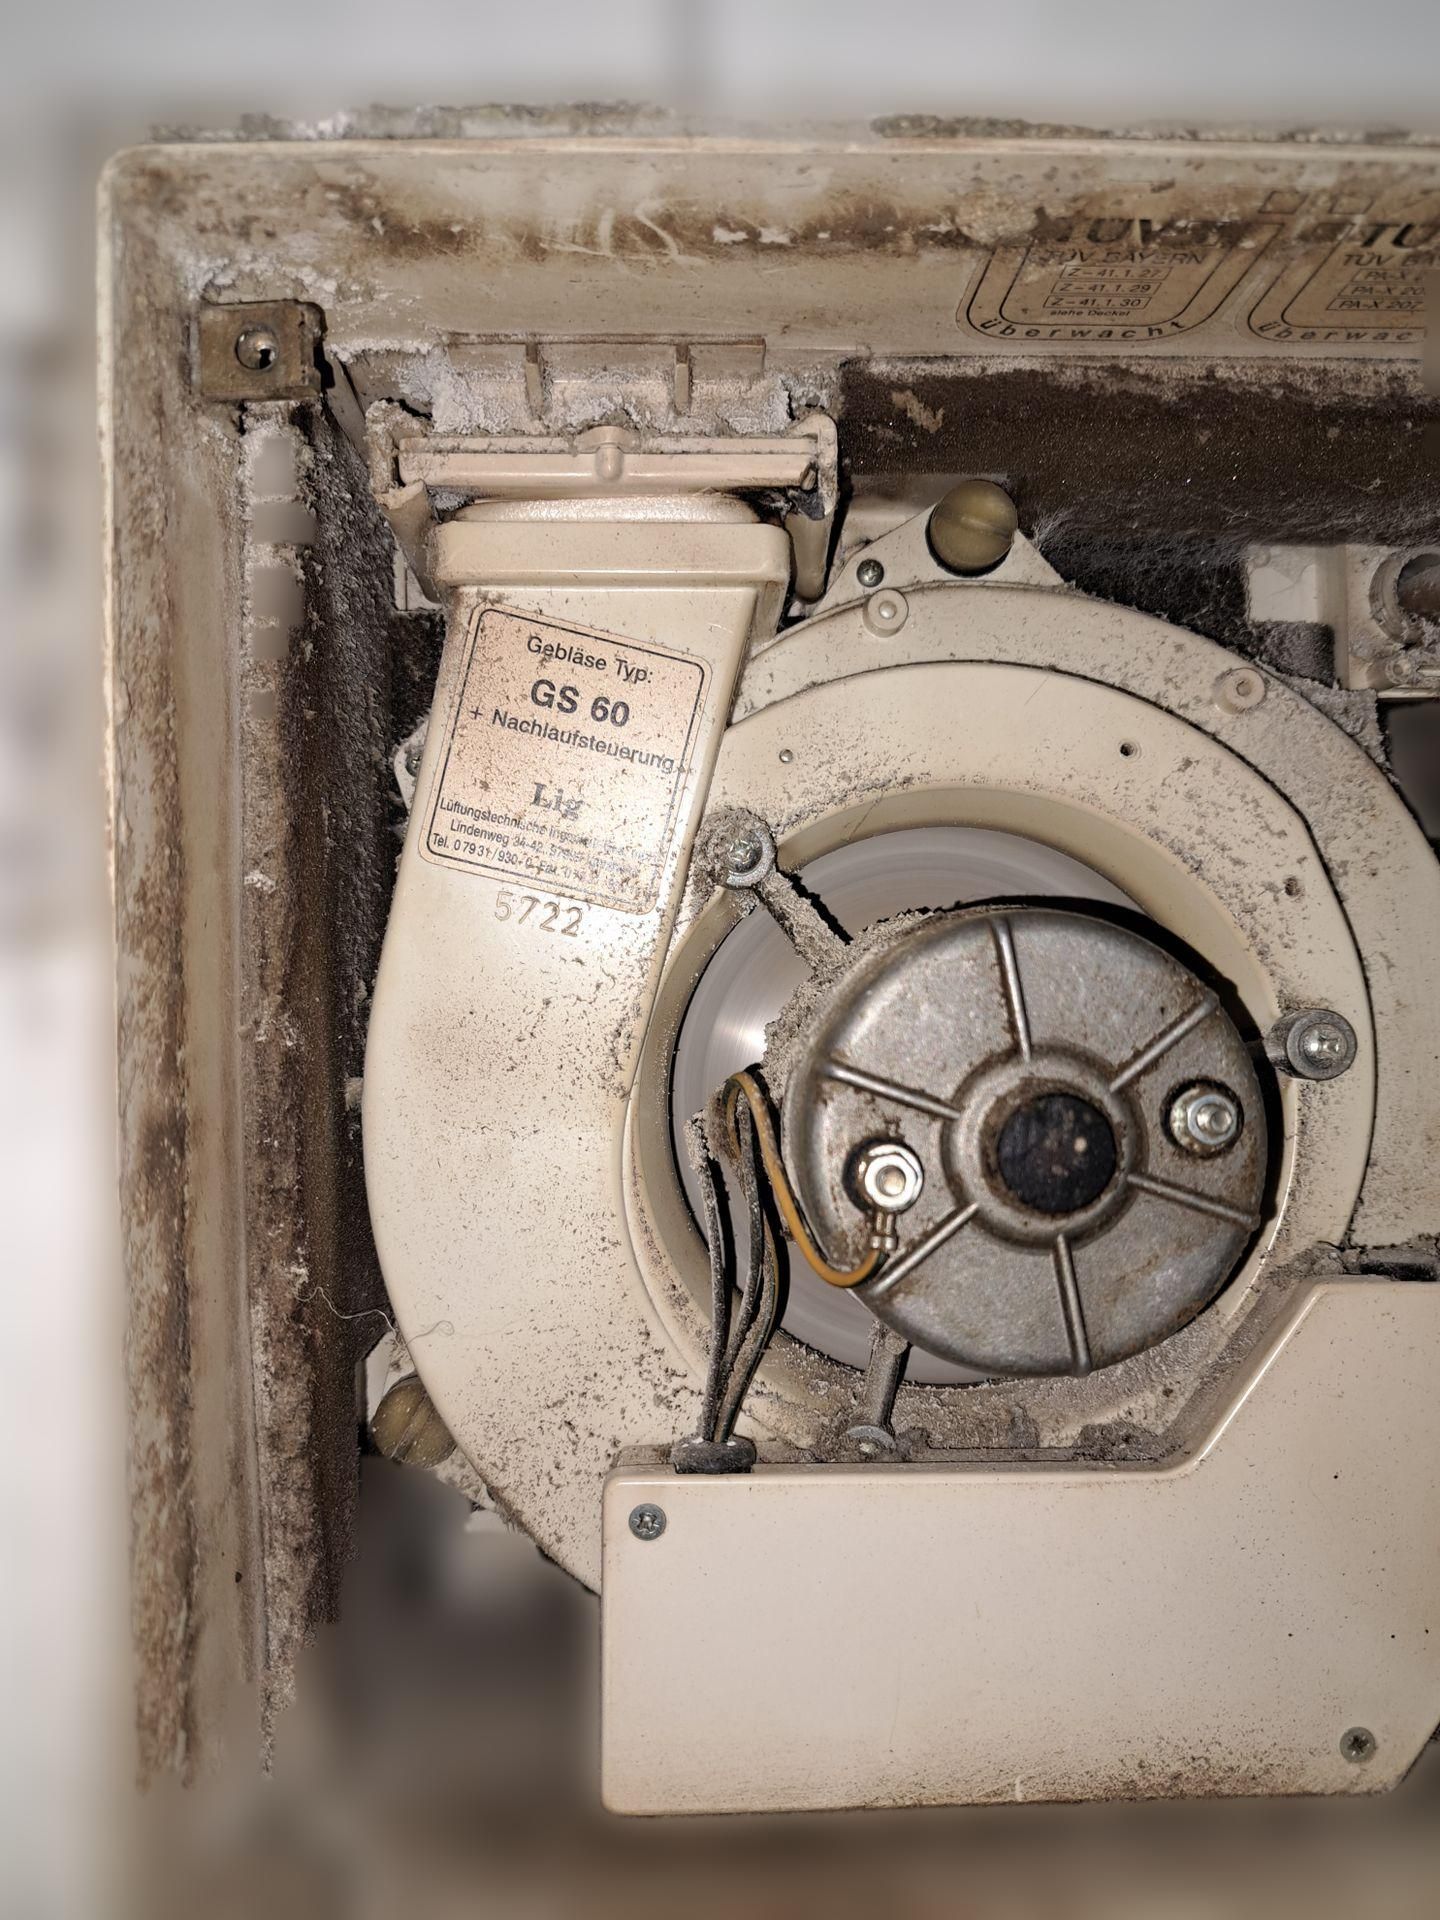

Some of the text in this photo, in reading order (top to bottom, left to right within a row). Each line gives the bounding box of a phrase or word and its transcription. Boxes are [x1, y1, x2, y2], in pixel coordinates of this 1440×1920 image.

[1343, 252, 1395, 267] TÜV
[1087, 309, 1131, 317] Deckel
[980, 318, 1185, 339] überwacht
[1258, 321, 1424, 341] überwac
[527, 636, 653, 684] Gebläse Typ:
[530, 678, 631, 728] GS 60
[492, 709, 675, 774] Nachlaufsteuerung
[433, 832, 450, 849] Tel.
[450, 818, 510, 848] Lindenweg
[494, 890, 583, 937] 5722
